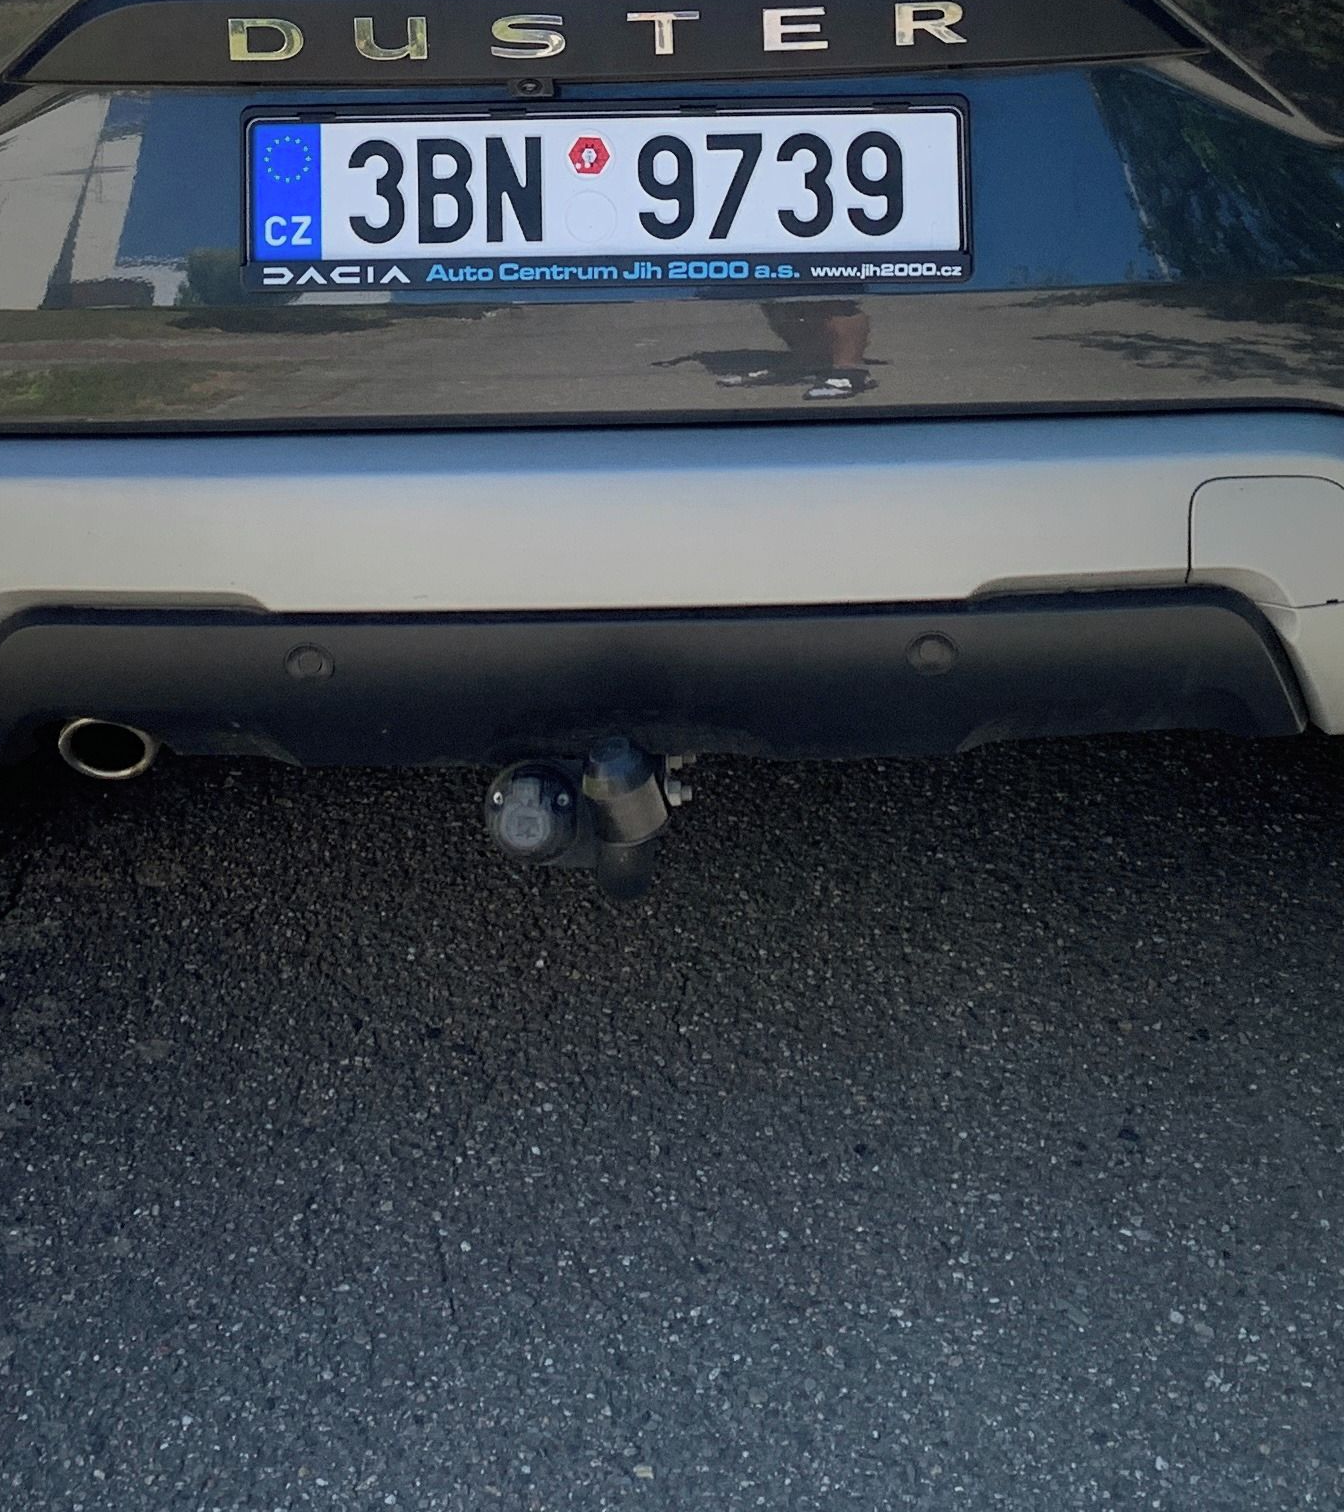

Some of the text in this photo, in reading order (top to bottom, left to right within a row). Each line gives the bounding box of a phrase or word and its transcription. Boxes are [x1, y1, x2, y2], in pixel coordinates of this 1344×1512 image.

[227, 0, 968, 62] DUSTER
[348, 130, 904, 244] 3BN 9739
[264, 215, 312, 246] CZ
[262, 260, 962, 285] DACIA Auto Centrum Jih 2000 a.s. www.jih2000.cz
